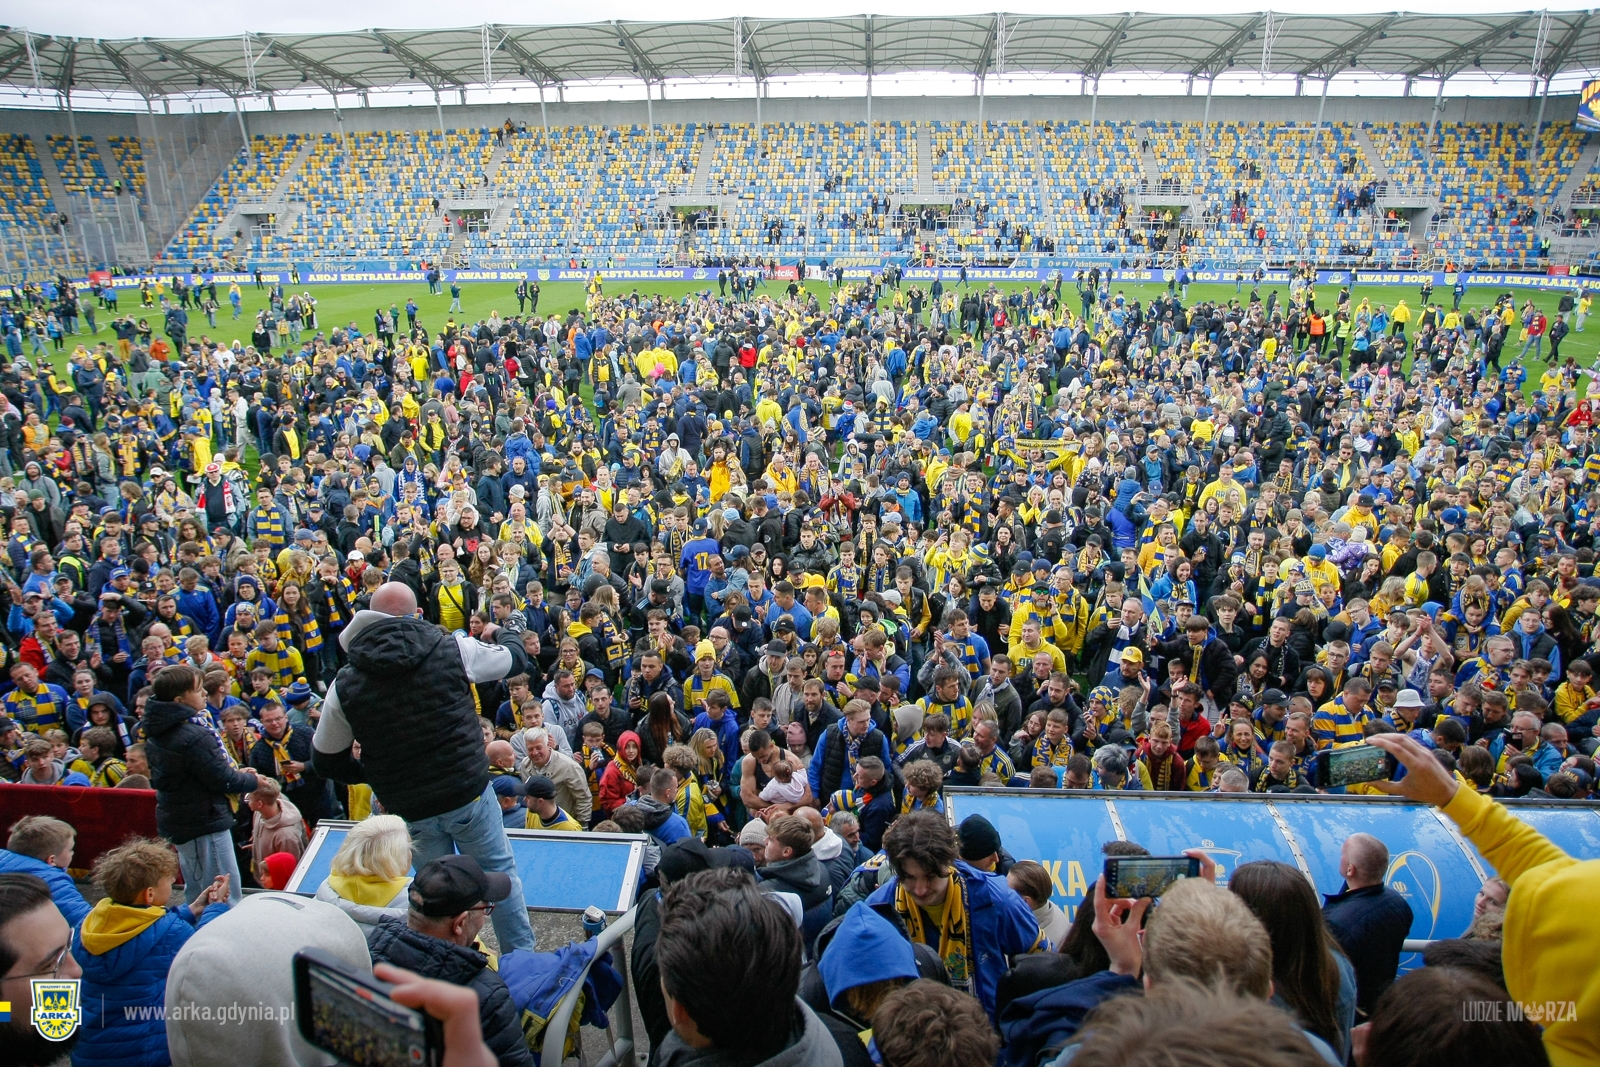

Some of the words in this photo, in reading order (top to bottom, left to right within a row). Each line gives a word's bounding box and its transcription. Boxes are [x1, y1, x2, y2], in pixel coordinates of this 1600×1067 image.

[479, 260, 511, 270] ligenti
[833, 257, 881, 267] GDYNIA
[212, 274, 252, 283] AWANS
[253, 274, 280, 283] 025
[308, 273, 338, 282] AHOJ
[340, 271, 425, 282] EKSTRAKLASO!
[455, 271, 498, 280] AWANS
[499, 271, 528, 280] 2025
[559, 271, 591, 279] AHOJ
[905, 269, 940, 278] AHOJ
[942, 269, 1038, 279] EKTRAKLASO!
[1466, 274, 1502, 284] AHOJ
[694, 551, 710, 571] 17
